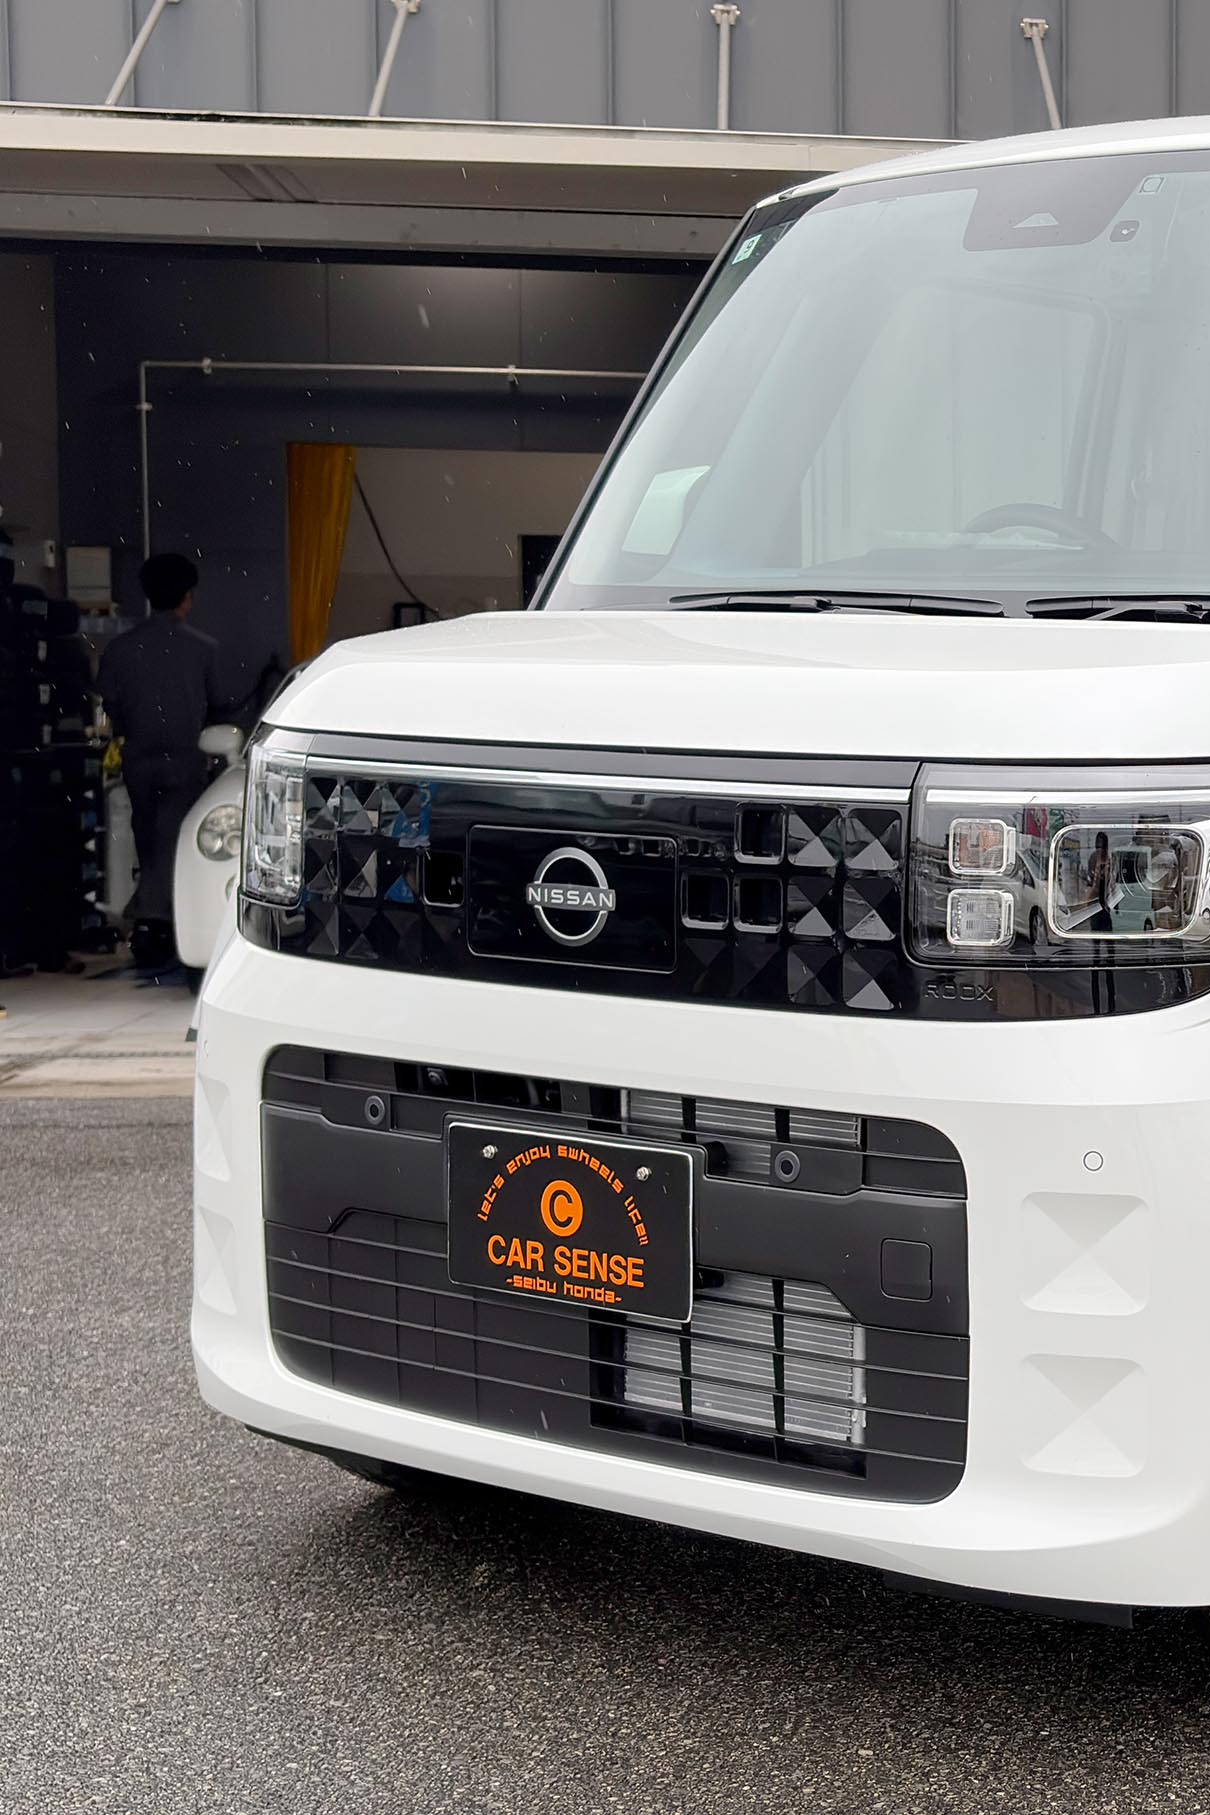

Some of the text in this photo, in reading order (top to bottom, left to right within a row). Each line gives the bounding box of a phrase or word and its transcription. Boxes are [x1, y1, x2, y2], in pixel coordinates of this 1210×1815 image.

[528, 886, 613, 908] NISSAN
[924, 984, 993, 1001] ROOX
[506, 1145, 551, 1175] enjoy
[488, 1235, 644, 1287] CAR SENSE
